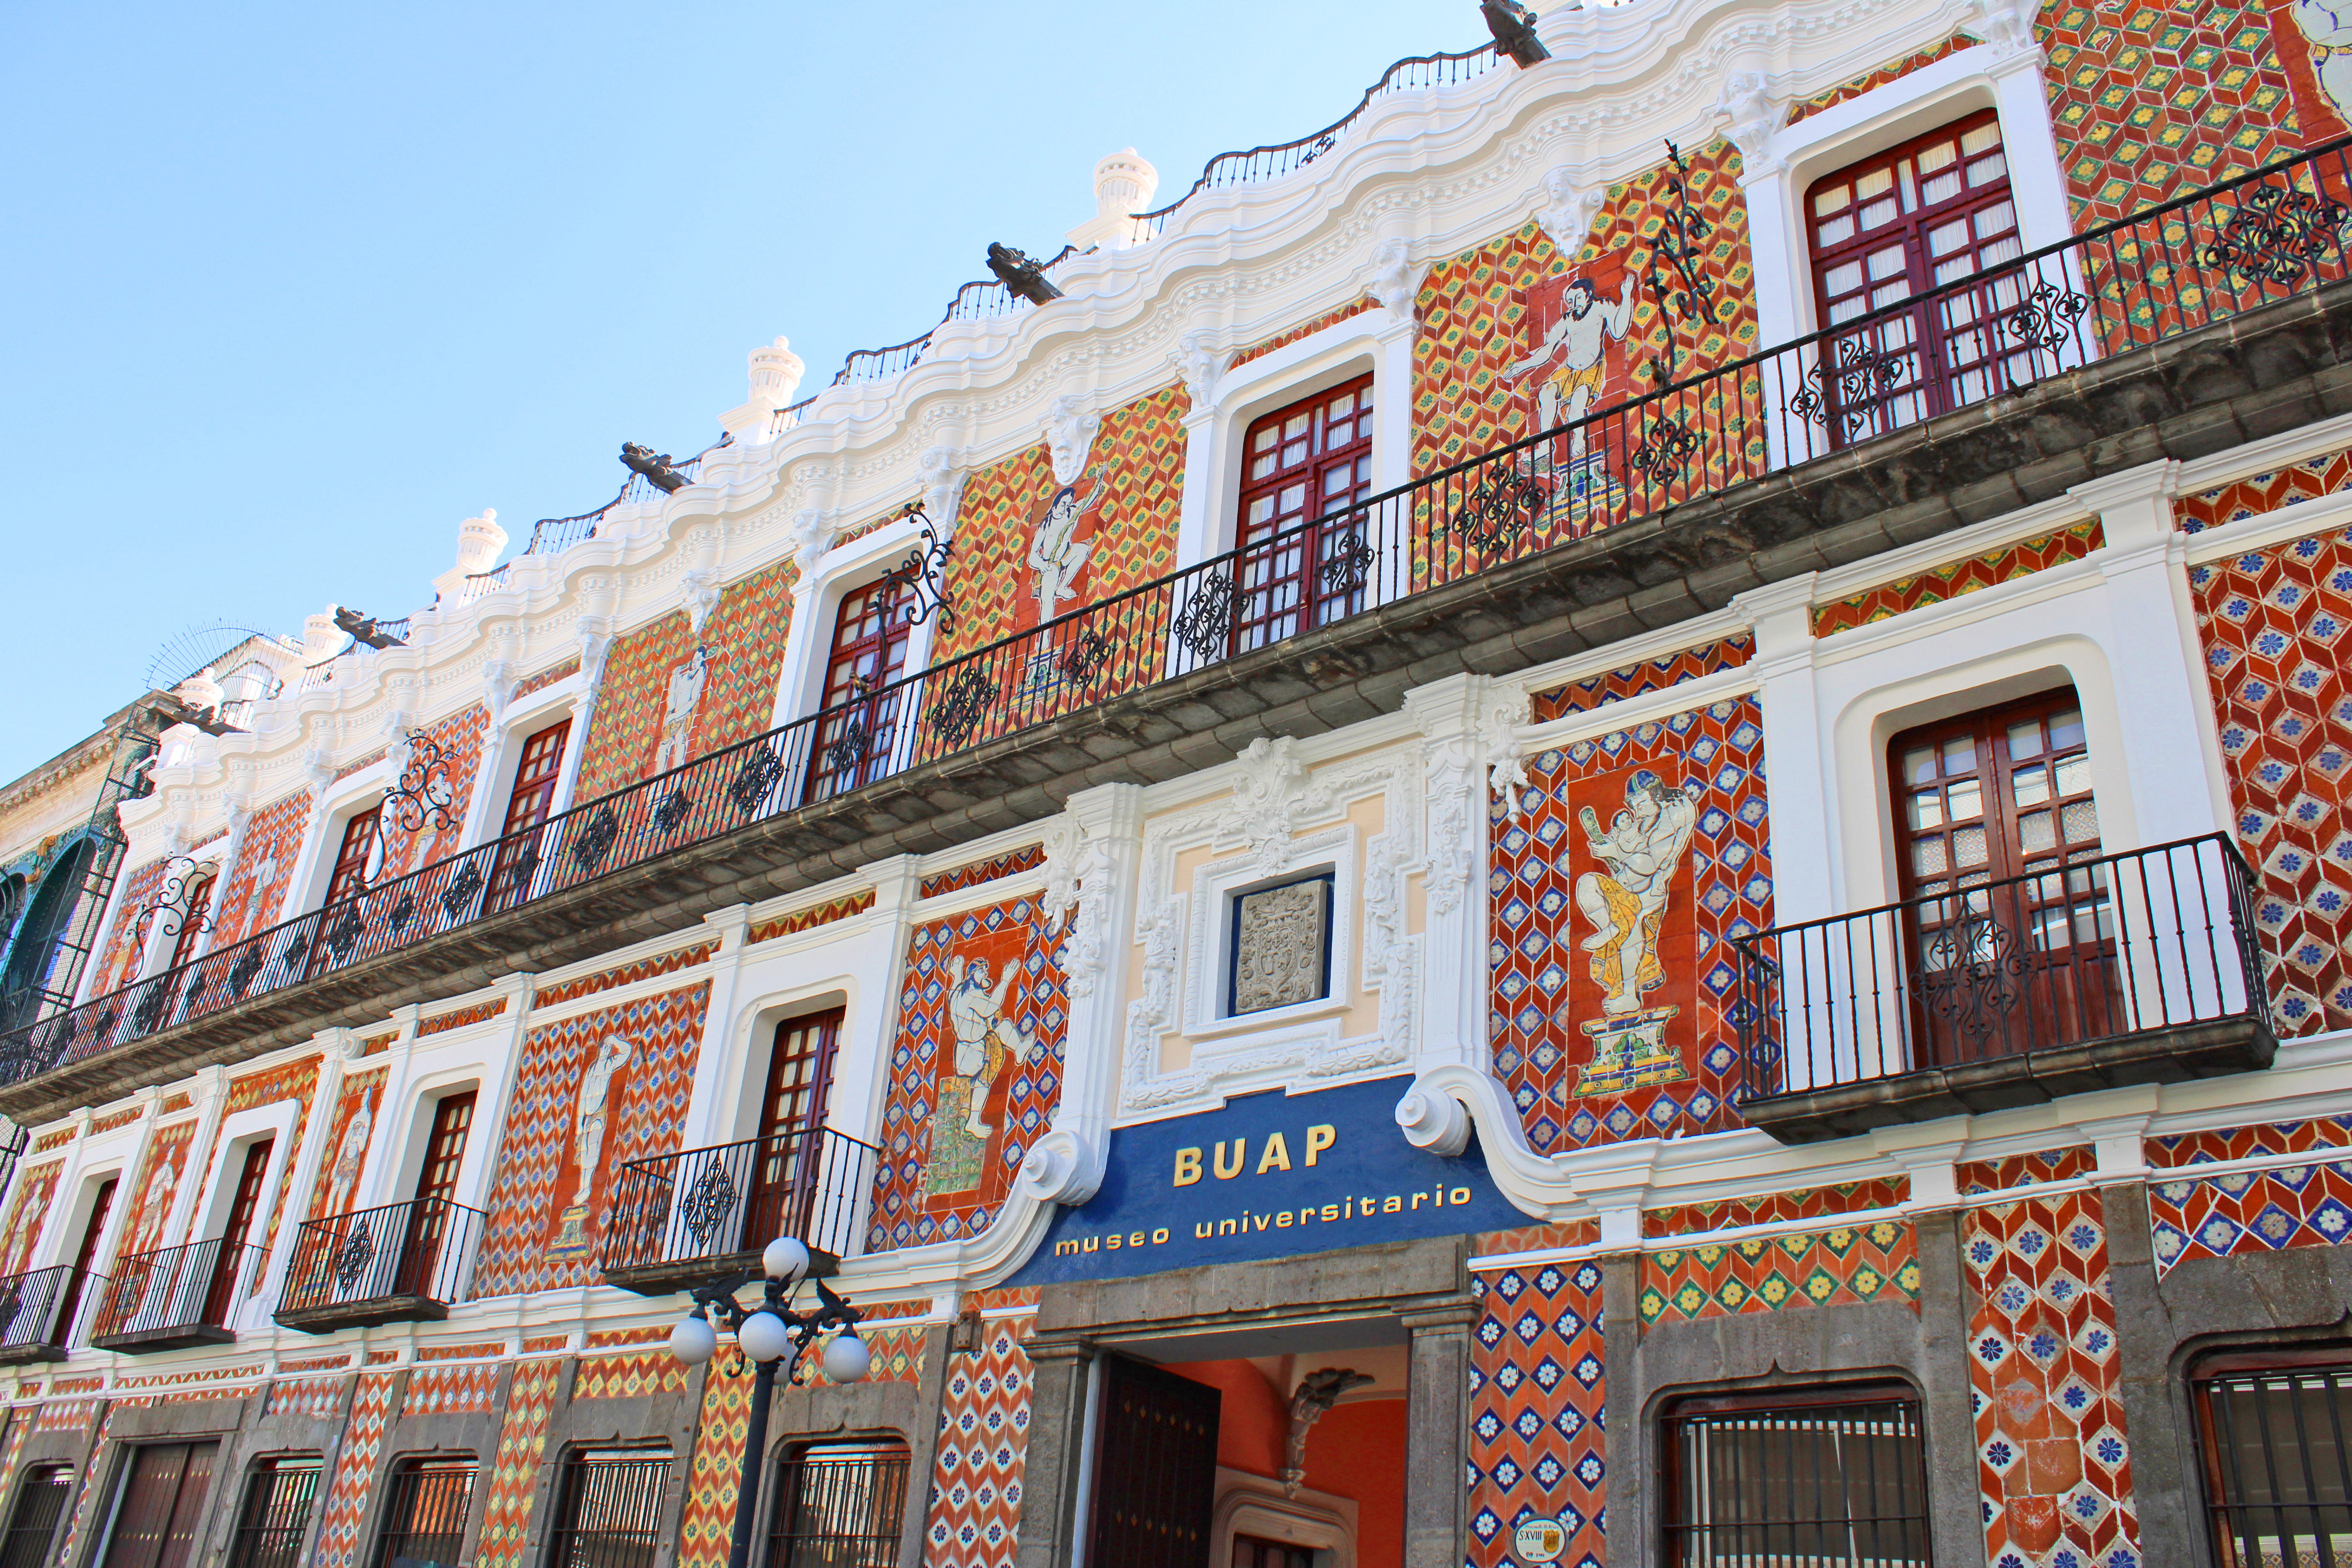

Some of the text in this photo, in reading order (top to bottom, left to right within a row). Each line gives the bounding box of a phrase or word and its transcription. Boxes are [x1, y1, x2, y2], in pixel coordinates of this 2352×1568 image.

[1173, 1123, 1337, 1187] BUAP
[1055, 1184, 1471, 1257] museo universitario
